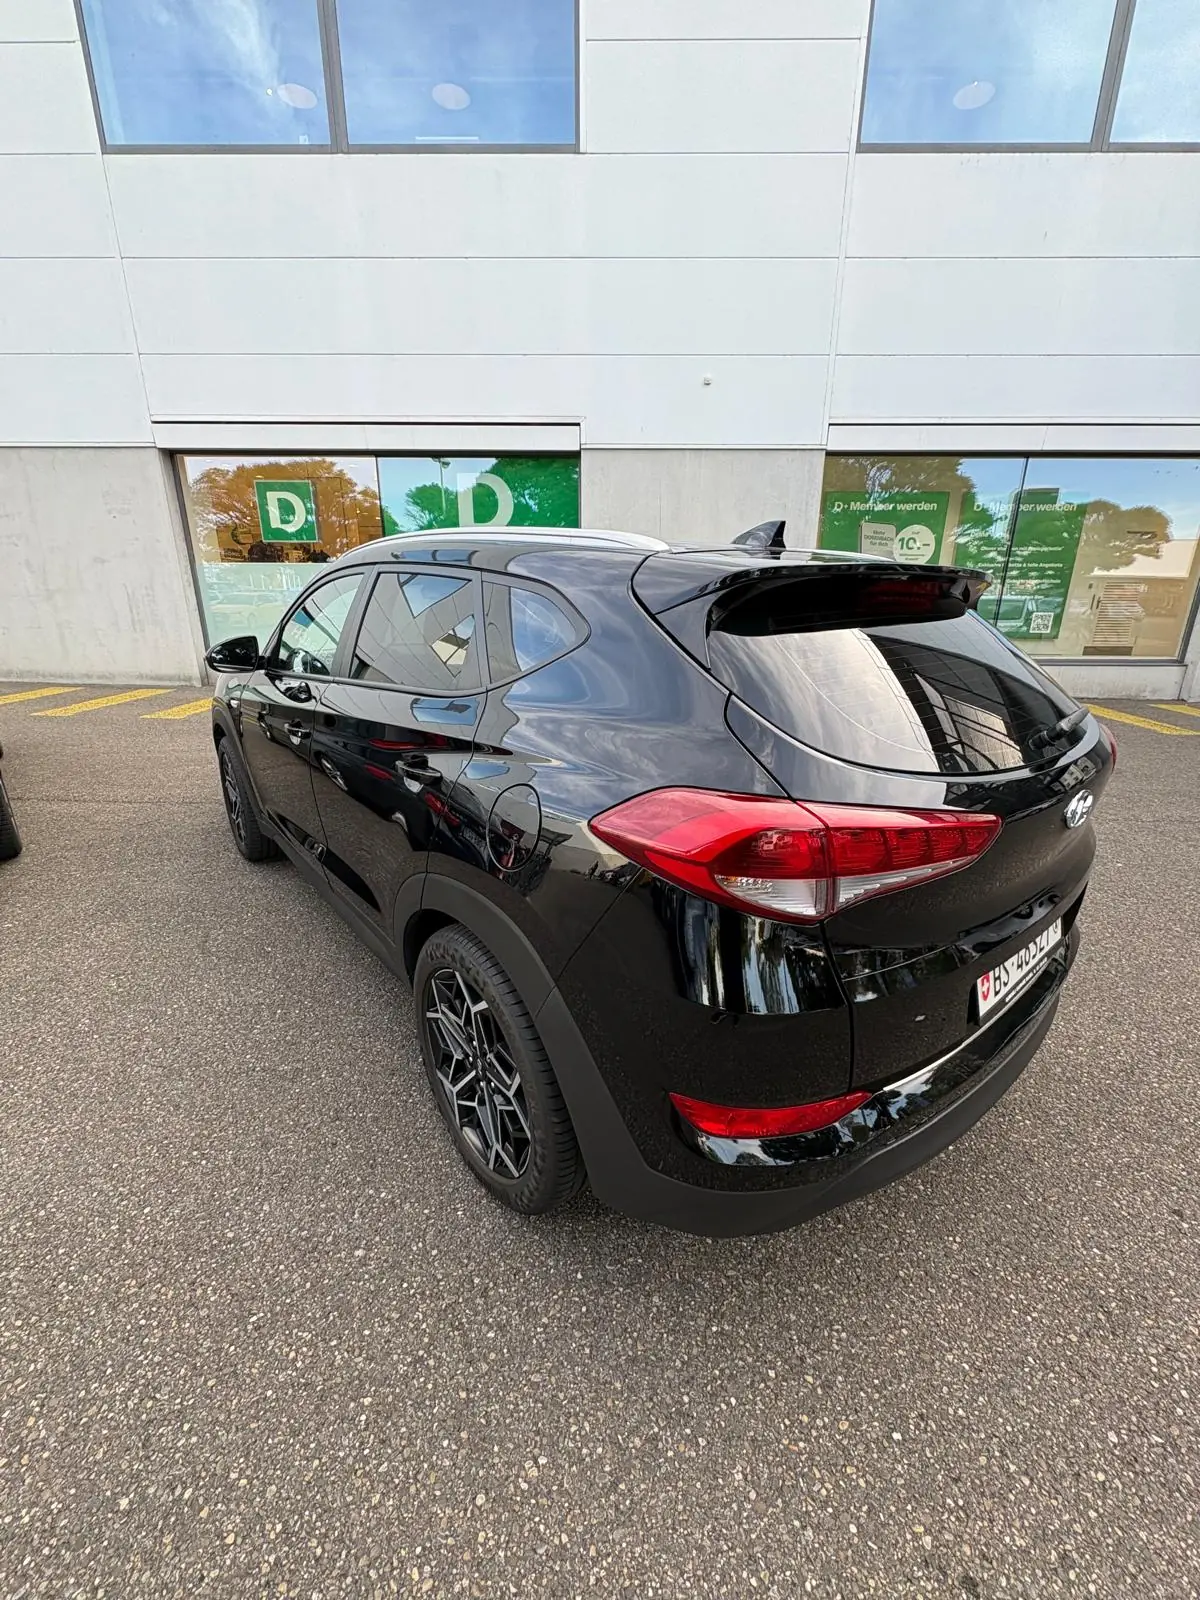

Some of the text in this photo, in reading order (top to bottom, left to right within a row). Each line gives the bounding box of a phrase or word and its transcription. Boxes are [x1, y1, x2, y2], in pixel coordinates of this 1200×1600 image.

[266, 491, 306, 533] D
[457, 472, 514, 527] D
[850, 501, 895, 512] Member
[897, 501, 938, 512] werden
